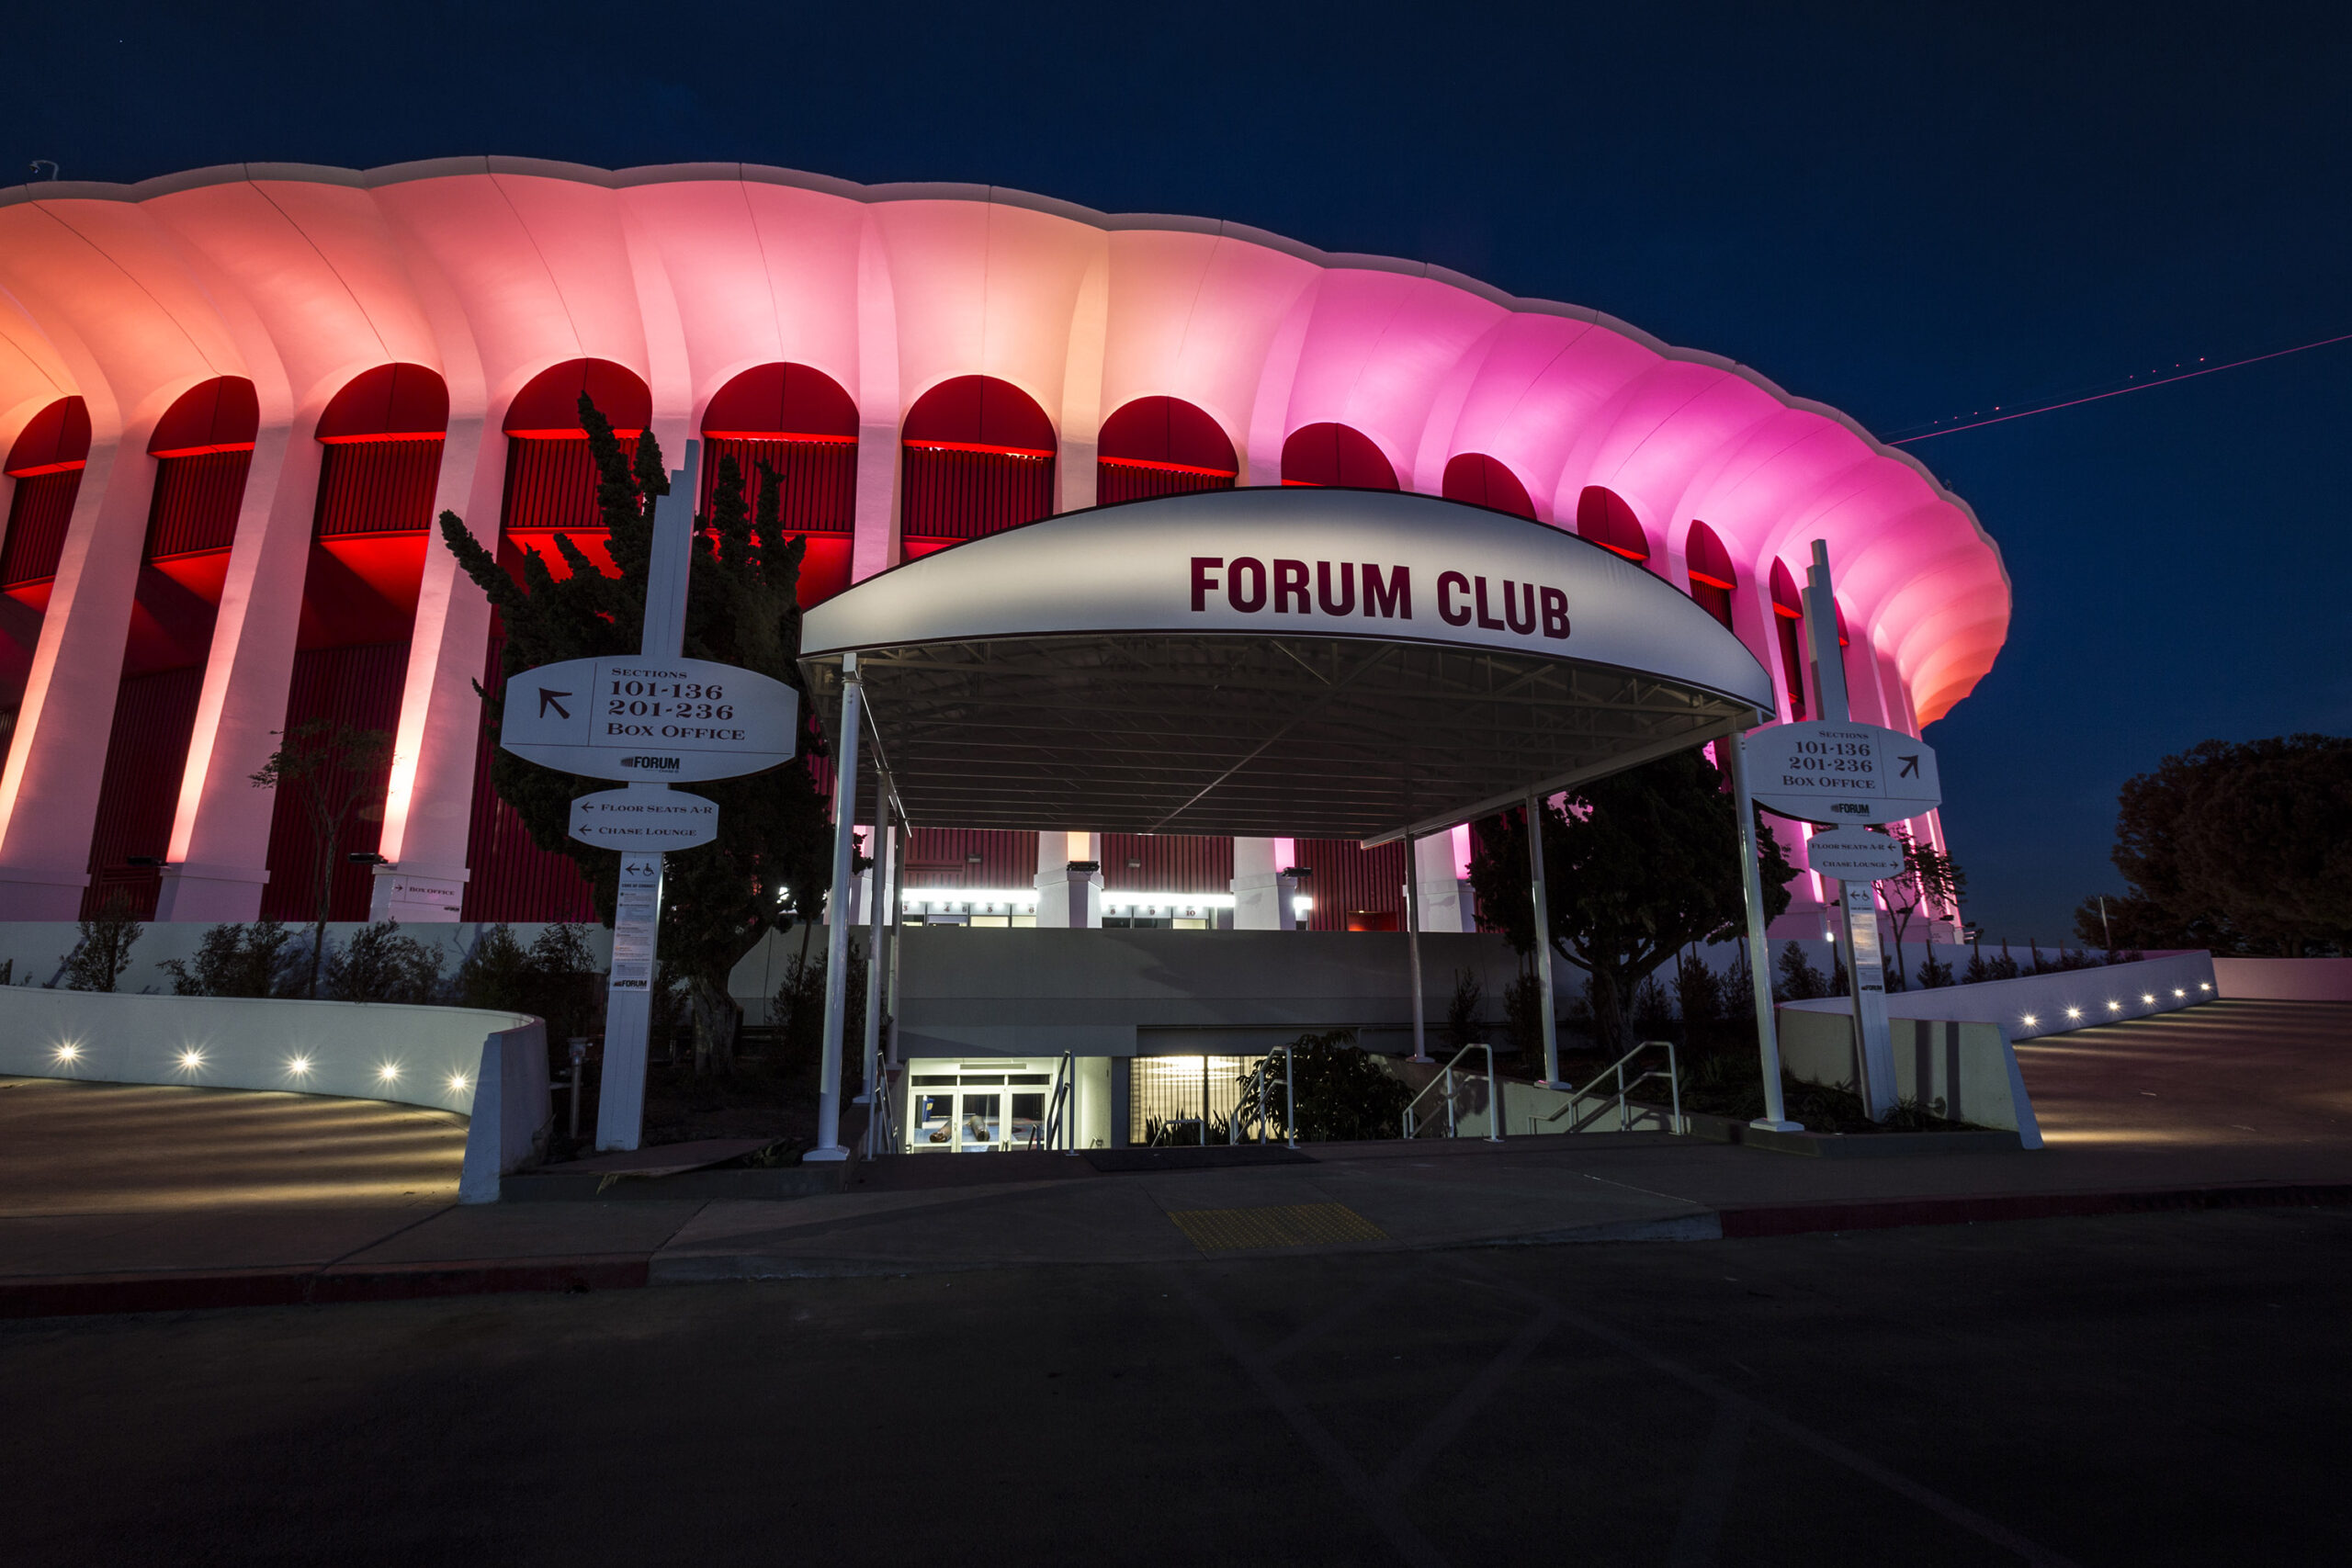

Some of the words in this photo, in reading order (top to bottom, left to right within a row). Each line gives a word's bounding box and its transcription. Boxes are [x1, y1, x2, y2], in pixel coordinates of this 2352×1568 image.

[1191, 557, 1412, 620] FORUM
[1437, 570, 1571, 639] CLUB
[611, 668, 687, 679] SECTIONS
[610, 681, 723, 700] 101-136
[608, 699, 734, 720] 201-236
[606, 722, 654, 737] BOX
[661, 725, 746, 741] OFFICE
[1818, 730, 1870, 739] SECTIONS
[1795, 740, 1871, 757] 101-136
[634, 757, 680, 769] FORUM
[1789, 756, 1873, 773] 201-236
[1782, 774, 1815, 786] BOX
[1818, 776, 1876, 789] OFFICE
[601, 804, 644, 813] FLOOR
[646, 805, 687, 814] SEATS
[1838, 803, 1871, 814] FORUM
[598, 826, 643, 835] CHASE
[646, 828, 697, 837] LOUNGE
